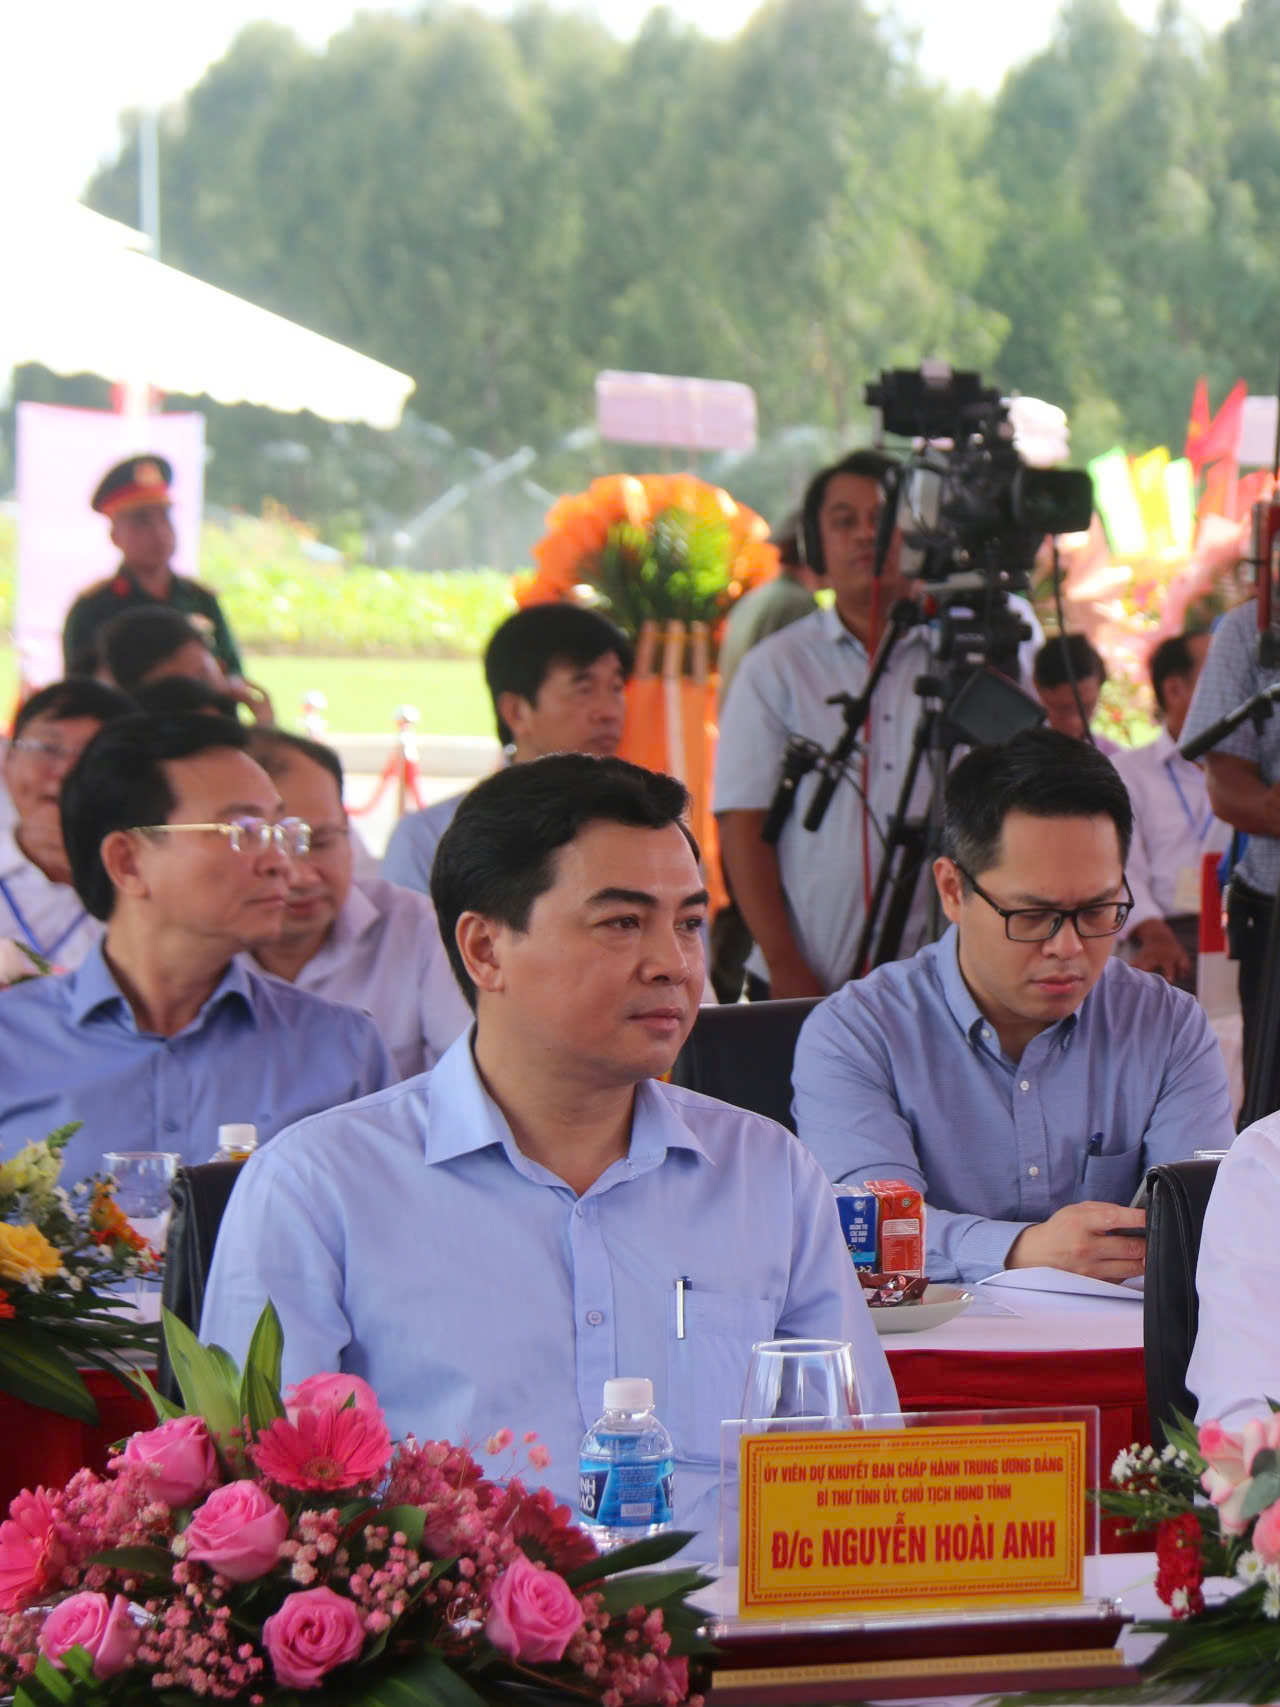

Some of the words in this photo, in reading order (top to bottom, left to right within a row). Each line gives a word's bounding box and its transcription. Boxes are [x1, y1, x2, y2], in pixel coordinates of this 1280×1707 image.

[782, 1463, 806, 1482] VIÊN
[828, 1459, 868, 1480] KHUYẾT
[872, 1462, 894, 1479] BAN
[898, 1457, 927, 1478] CHẤP
[930, 1457, 960, 1477] HÀNH
[963, 1458, 998, 1475] TRUNG
[831, 1487, 853, 1506] THƯ
[856, 1484, 880, 1505] TỈNH
[902, 1481, 923, 1503] CHỦ
[927, 1486, 951, 1505] TỊCH
[987, 1478, 1011, 1500] TỈNH
[771, 1529, 814, 1569] Đ/c
[822, 1512, 926, 1567] NGUYỄN
[935, 1513, 994, 1562] HOÀI
[1002, 1520, 1055, 1560] ANH
